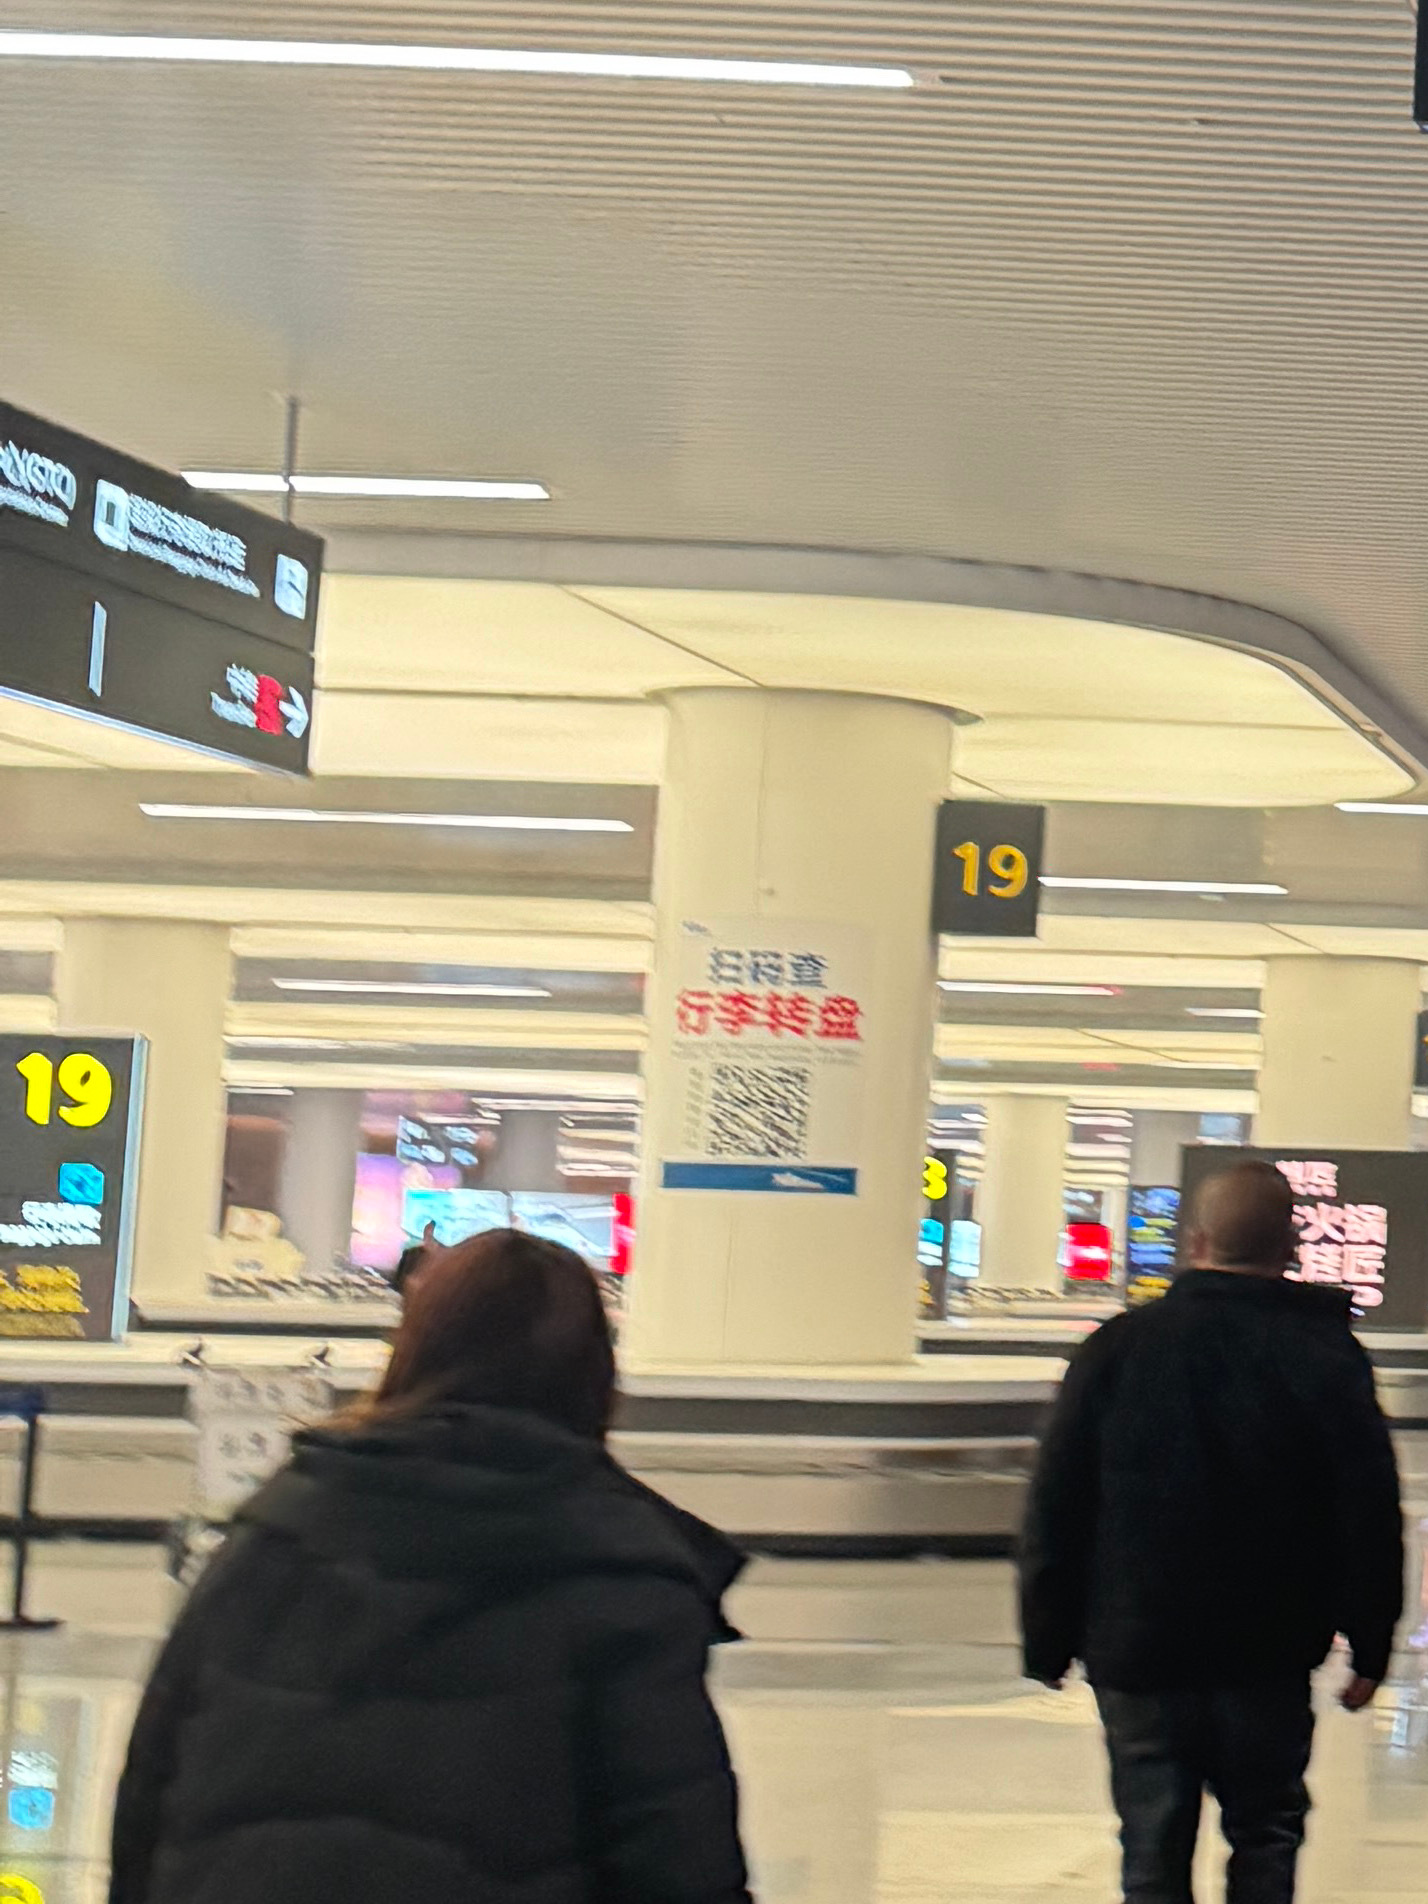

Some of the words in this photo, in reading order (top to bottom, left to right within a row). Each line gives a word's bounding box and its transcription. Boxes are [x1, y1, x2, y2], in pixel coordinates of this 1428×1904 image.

[952, 841, 1028, 898] 19
[675, 988, 863, 1041] 行李转盘
[15, 1052, 112, 1127] 19
